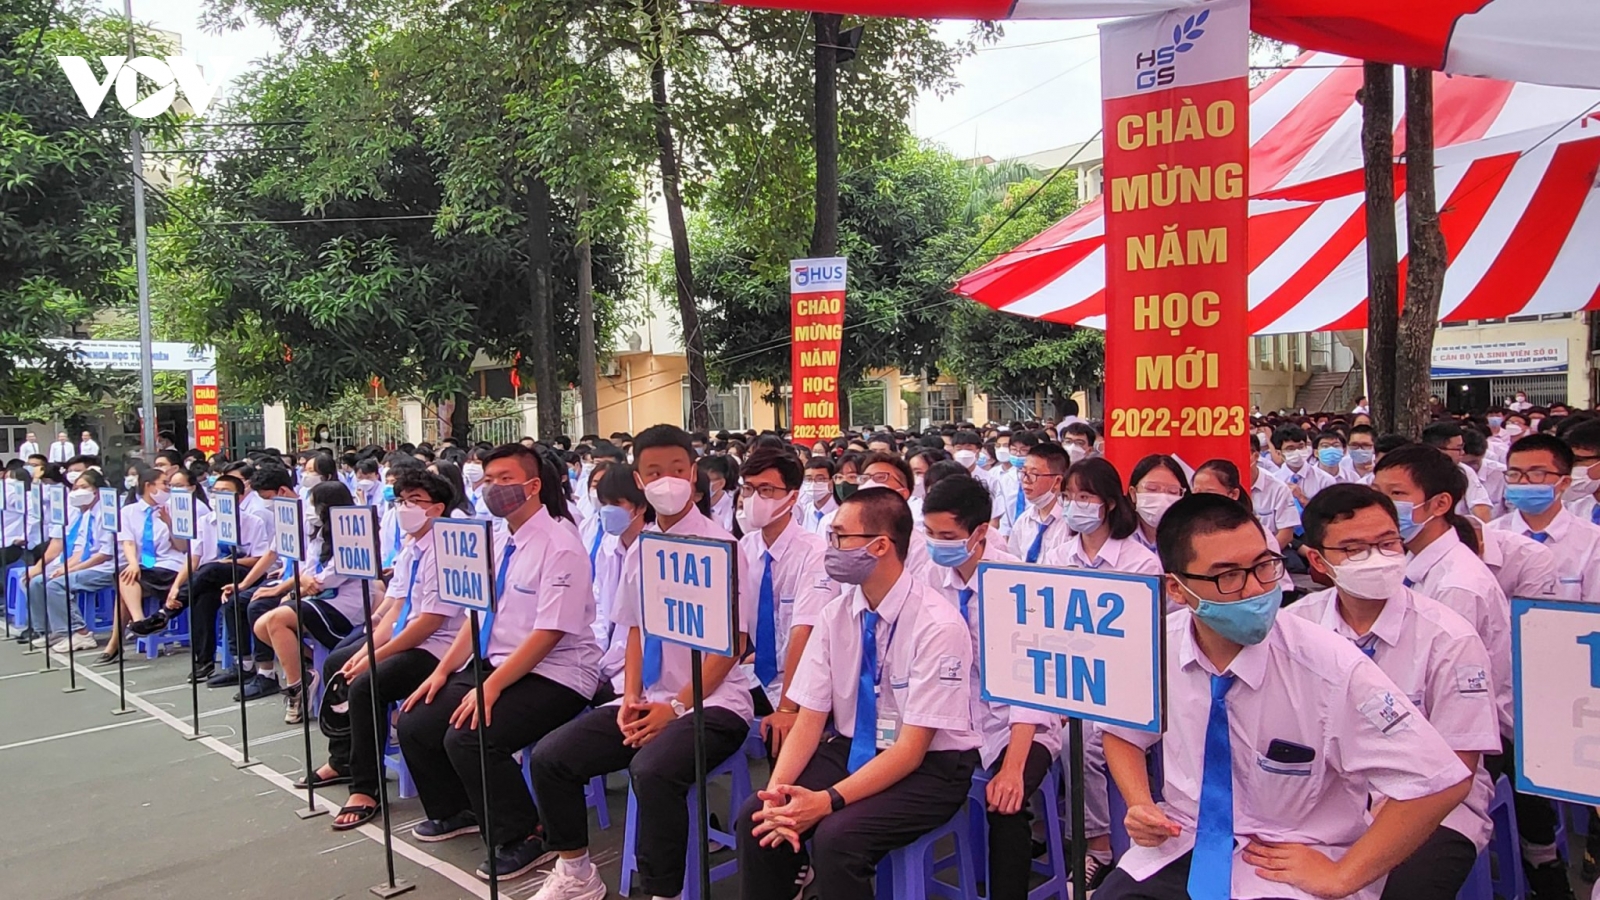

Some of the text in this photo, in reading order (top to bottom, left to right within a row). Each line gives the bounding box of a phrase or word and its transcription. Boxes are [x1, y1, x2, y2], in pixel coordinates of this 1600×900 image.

[1117, 98, 1235, 151] CHÀO
[1111, 162, 1243, 213] MỪNG
[1126, 223, 1228, 272] NĂM
[810, 266, 843, 280] HUS
[797, 296, 841, 316] CHÀO
[1134, 291, 1220, 336] HỌC
[794, 324, 842, 342] MỪNG
[800, 349, 837, 368] NĂM
[1136, 346, 1219, 391] MỚI
[195, 387, 216, 399] CHÀO
[802, 376, 835, 396] HỌC
[803, 400, 834, 419] MỚI
[1110, 405, 1245, 438] 2022-2023
[198, 418, 216, 431] NĂM
[200, 435, 215, 448] HỌC
[177, 517, 188, 533] CLC
[221, 521, 233, 539] CLC
[338, 514, 366, 537] 11A1
[281, 532, 294, 553] CLC
[442, 530, 478, 559] 11A2
[338, 542, 371, 571] TOÁN
[656, 549, 711, 588] 11A1
[442, 565, 483, 601] TOÁN
[664, 597, 704, 639] TIN
[1009, 583, 1125, 638] 11A2
[1026, 648, 1107, 707] TIN
